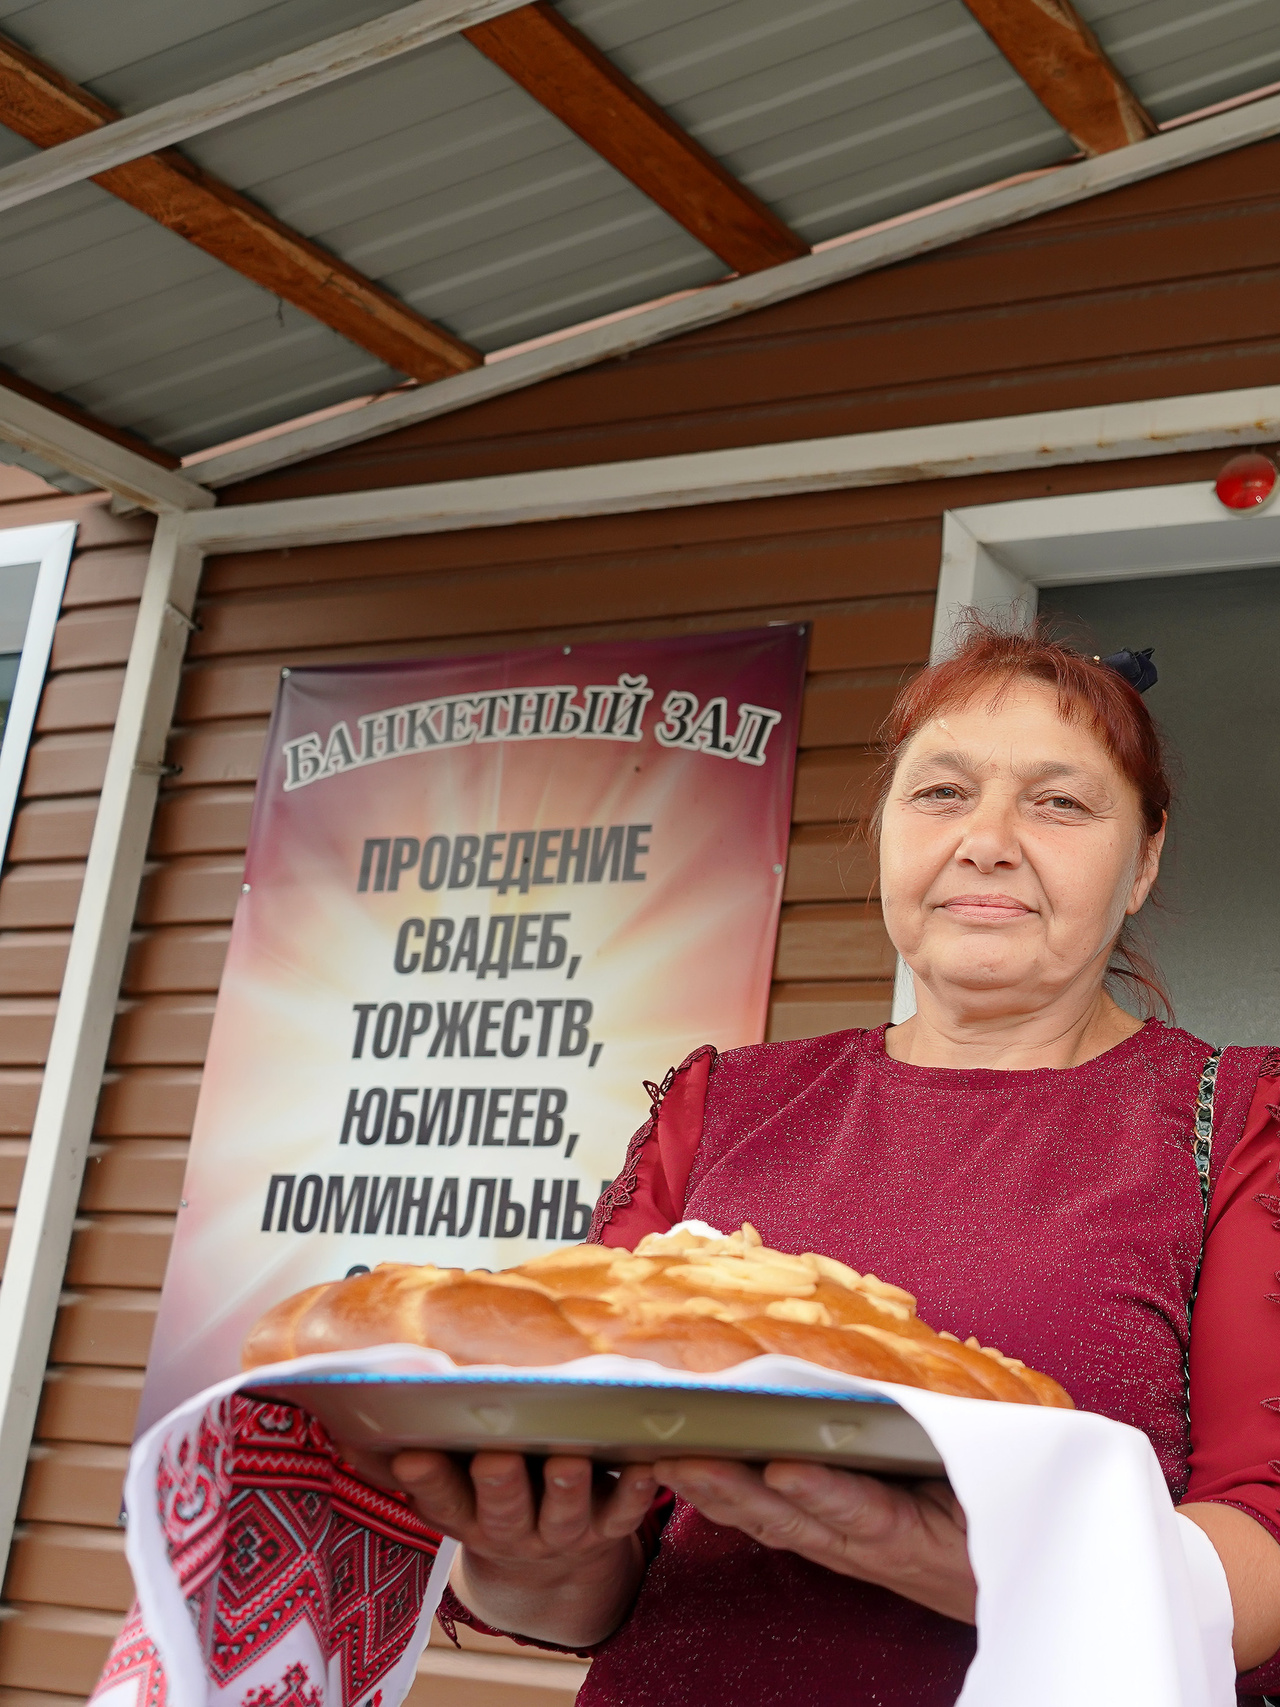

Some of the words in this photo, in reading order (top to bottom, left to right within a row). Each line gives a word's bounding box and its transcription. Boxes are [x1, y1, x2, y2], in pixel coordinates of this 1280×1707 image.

[284, 674, 654, 792] БАНКЕТНЫЙ
[655, 690, 782, 766] ЗАЛ
[357, 825, 653, 895] ПРОВЕДЕНИЕ
[393, 913, 582, 980] СВАДЕБ,
[351, 998, 604, 1068] ТОРЖЕСТВ,
[338, 1087, 581, 1159] ЮБИЛЕЕВ,
